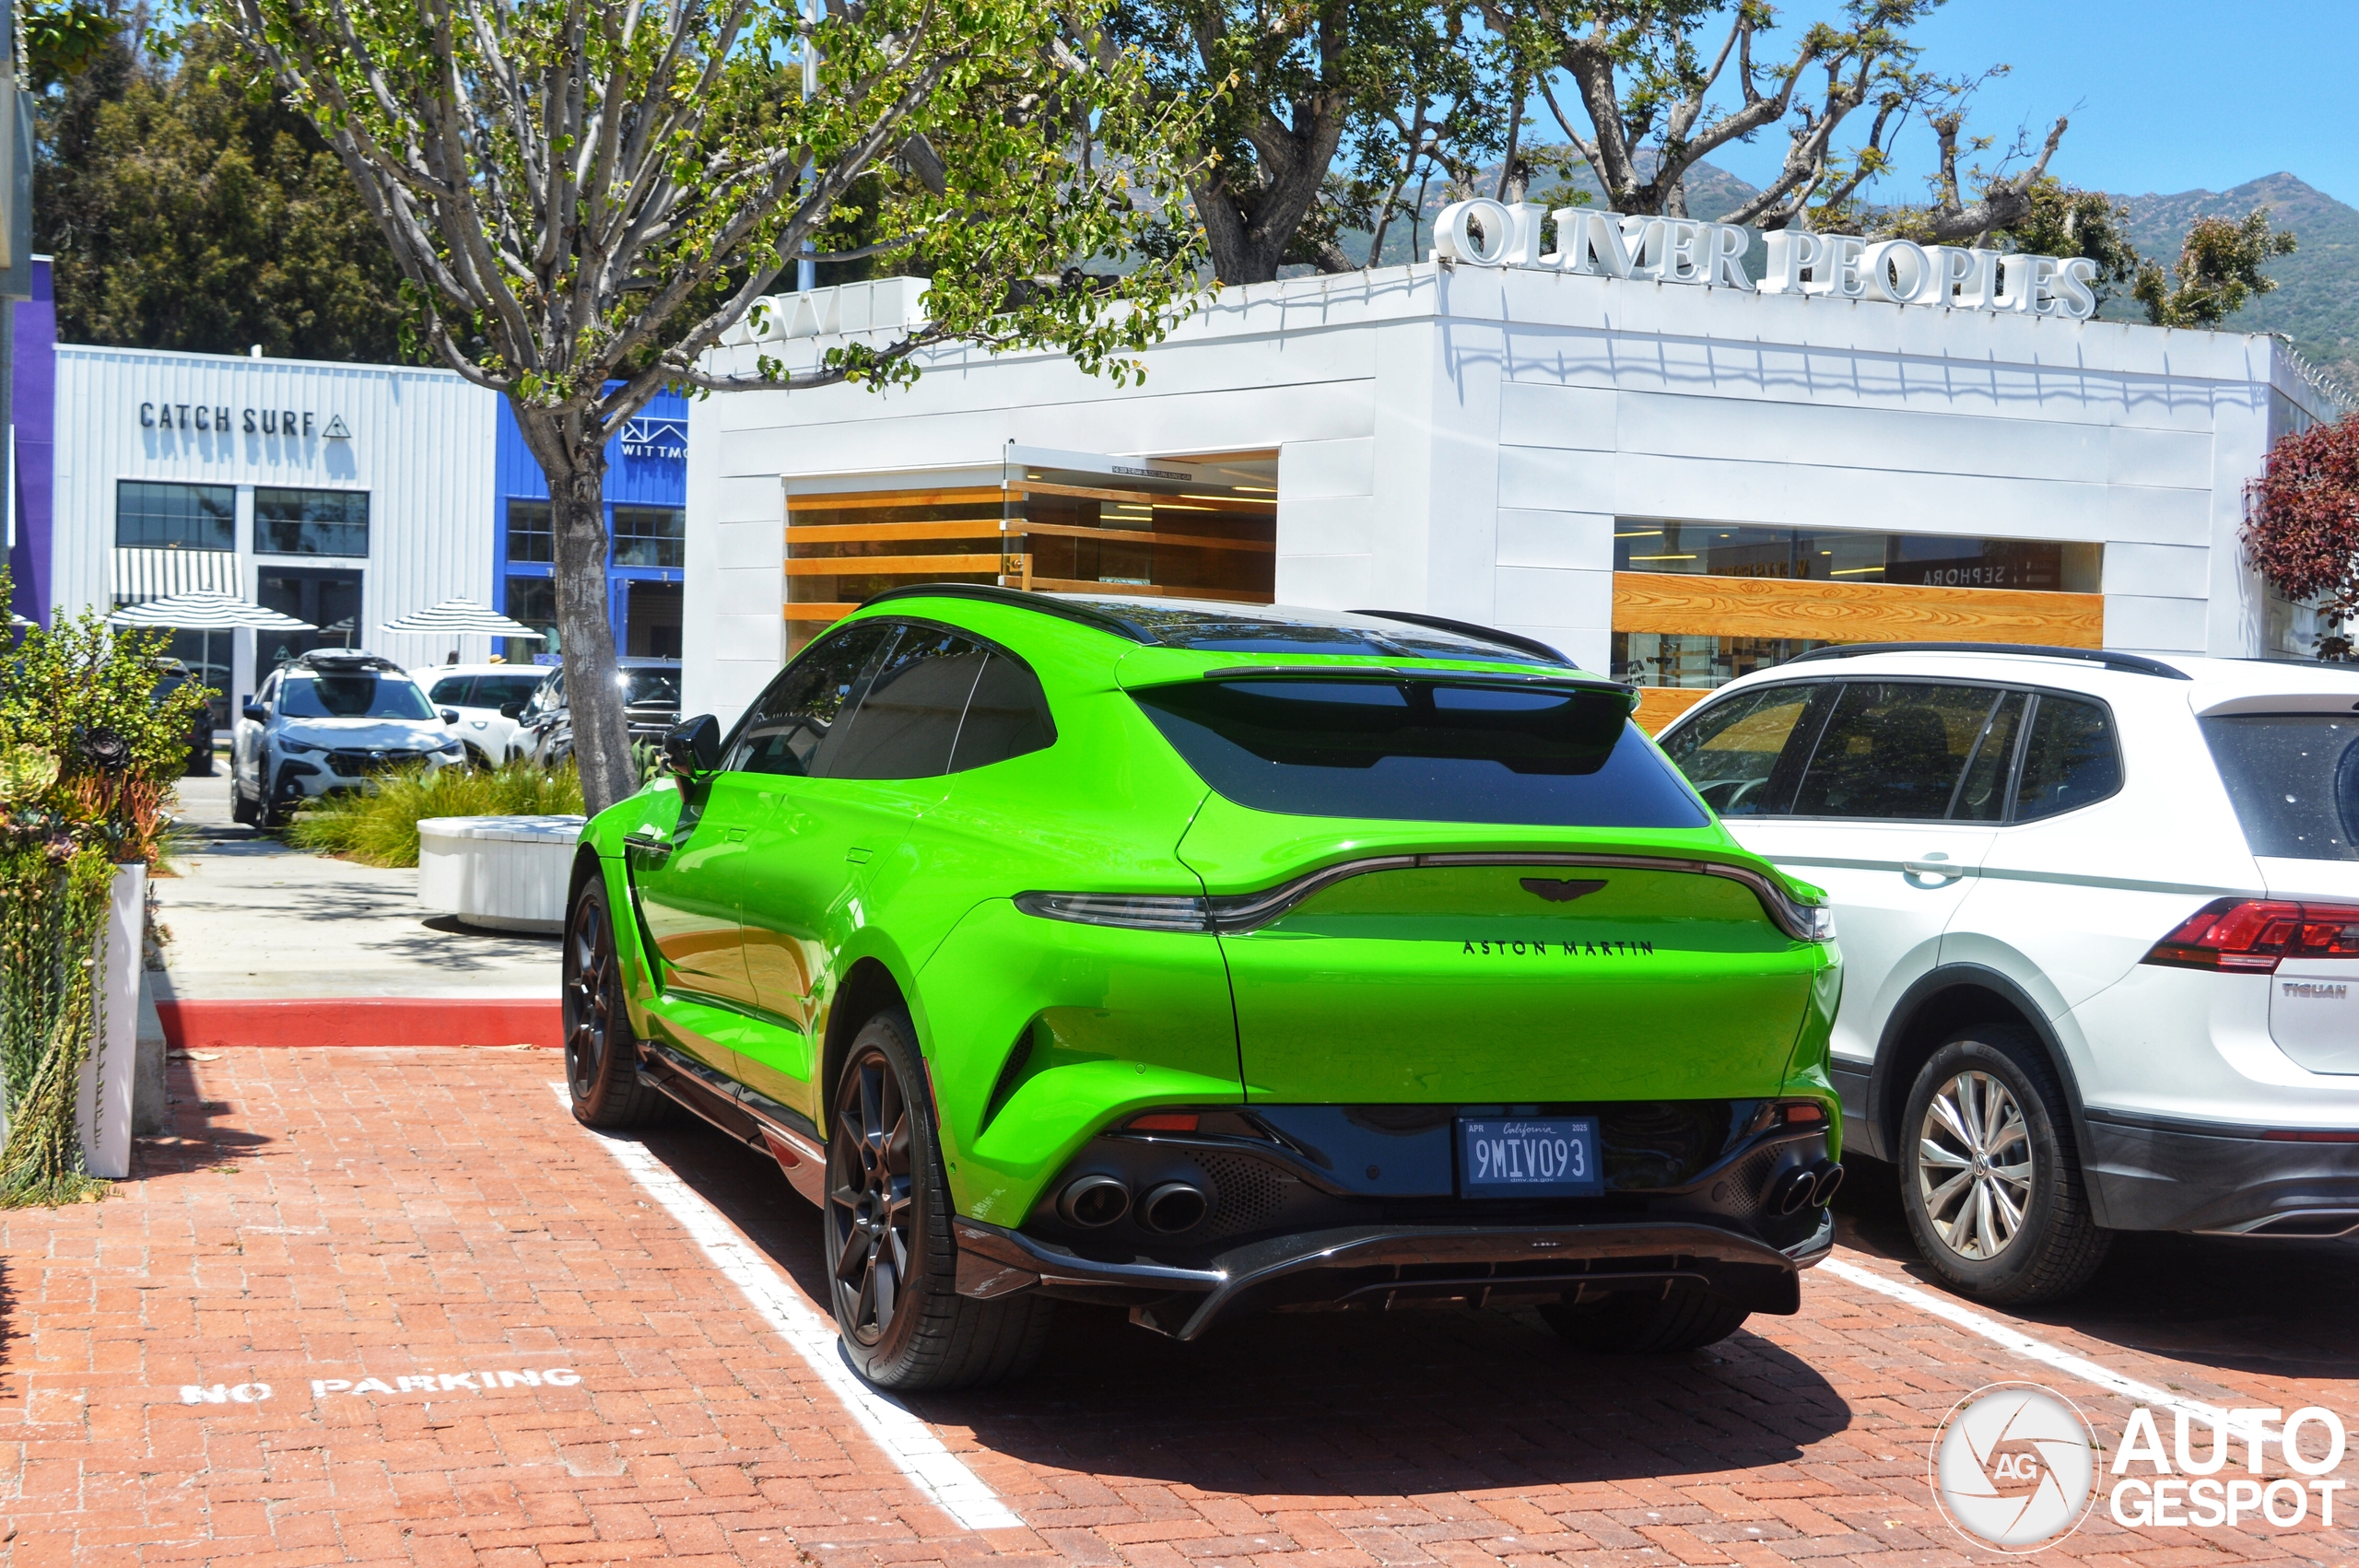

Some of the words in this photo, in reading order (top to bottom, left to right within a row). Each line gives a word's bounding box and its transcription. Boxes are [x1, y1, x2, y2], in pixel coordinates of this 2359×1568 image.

[1434, 197, 1755, 291] OLIVER
[1761, 228, 2096, 320] PEOPLES
[140, 402, 230, 432] CATCH
[243, 408, 315, 436] SURF
[1463, 940, 1546, 956] ASTON
[1563, 941, 1654, 956] MARTIN
[2282, 982, 2347, 1000] TIGUAN
[1469, 1124, 1485, 1132] APR
[1503, 1122, 1558, 1138] California
[1475, 1139, 1585, 1177] 9MIV093
[179, 1383, 274, 1405] NO
[311, 1368, 581, 1398] PARKING
